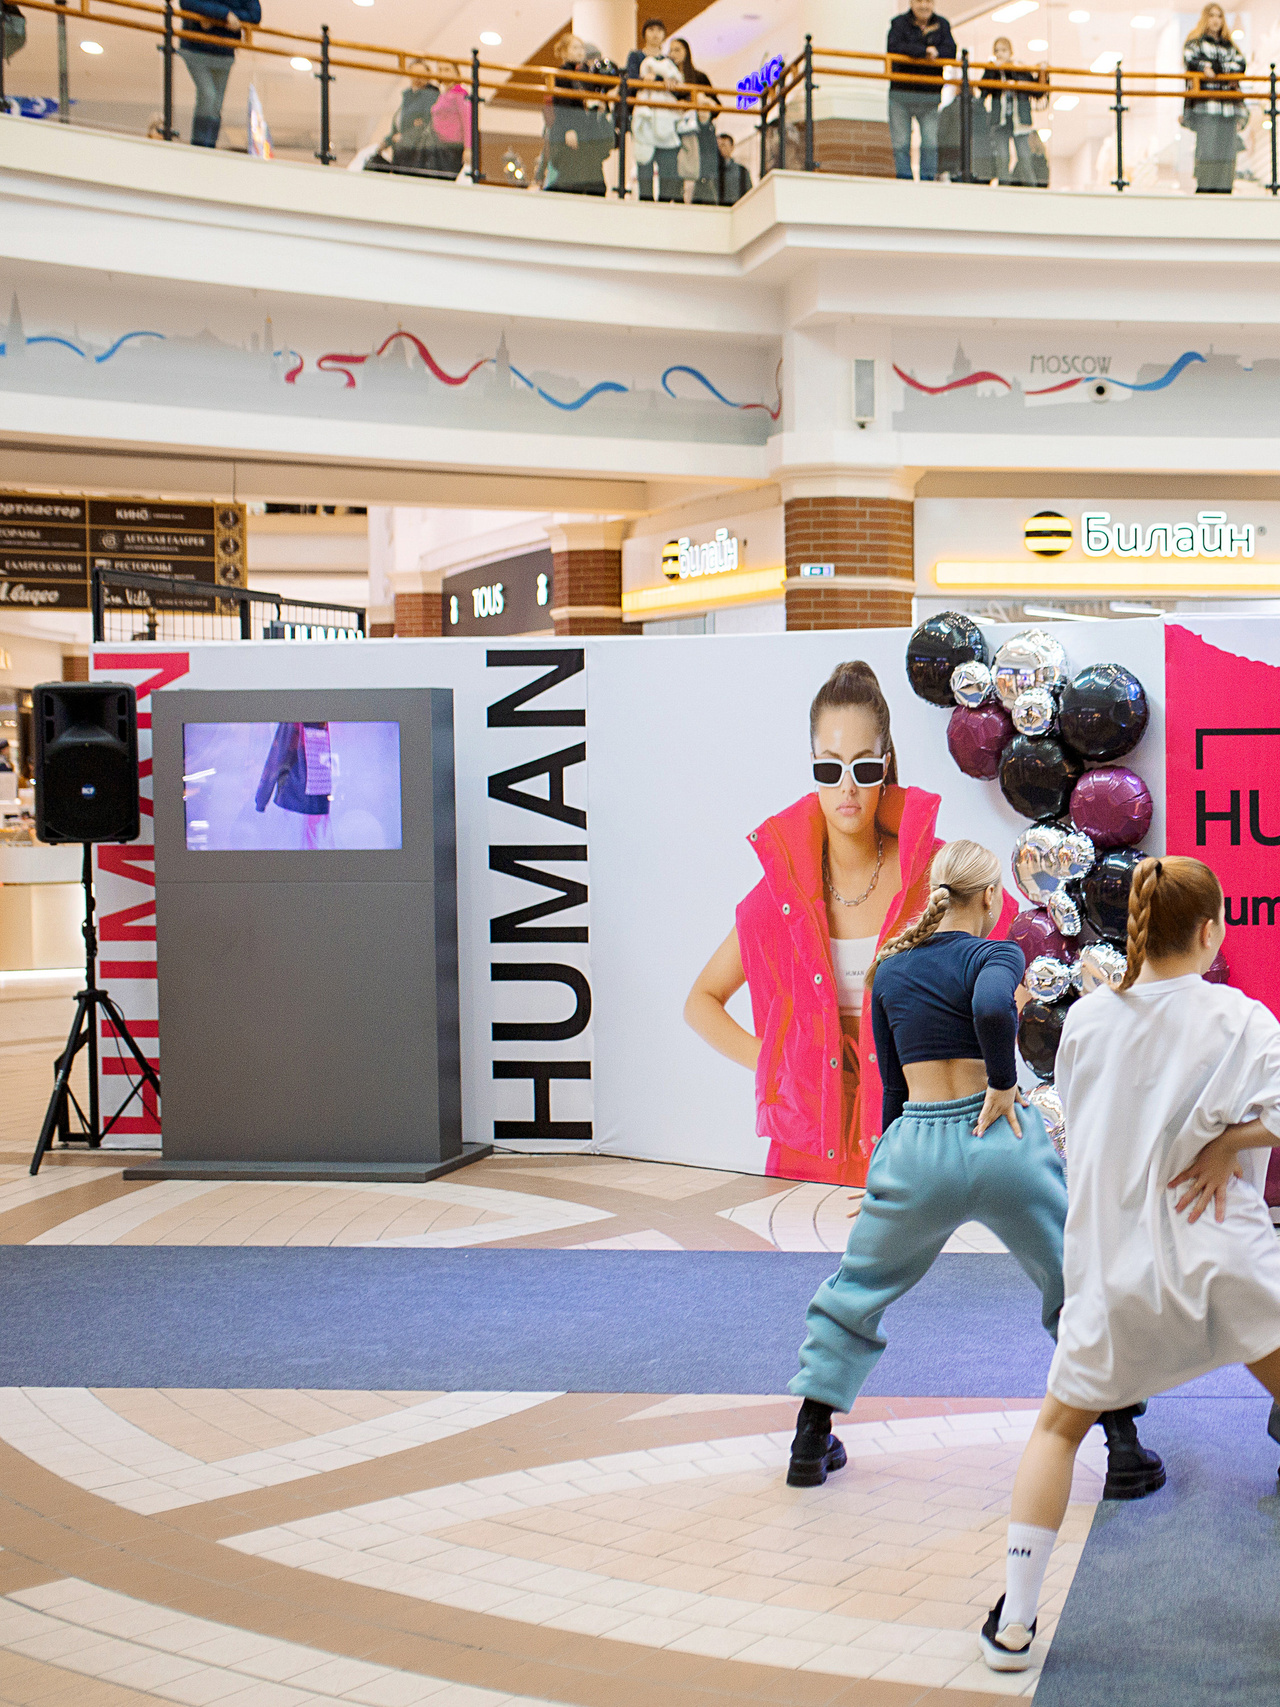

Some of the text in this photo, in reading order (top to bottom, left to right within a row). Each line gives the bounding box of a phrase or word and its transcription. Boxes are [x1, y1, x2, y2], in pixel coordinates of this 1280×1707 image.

[1030, 355, 1112, 374] MOSCOW
[1080, 511, 1255, 558] Билайн
[472, 583, 504, 618] TOUS
[486, 648, 592, 1140] HUMAN
